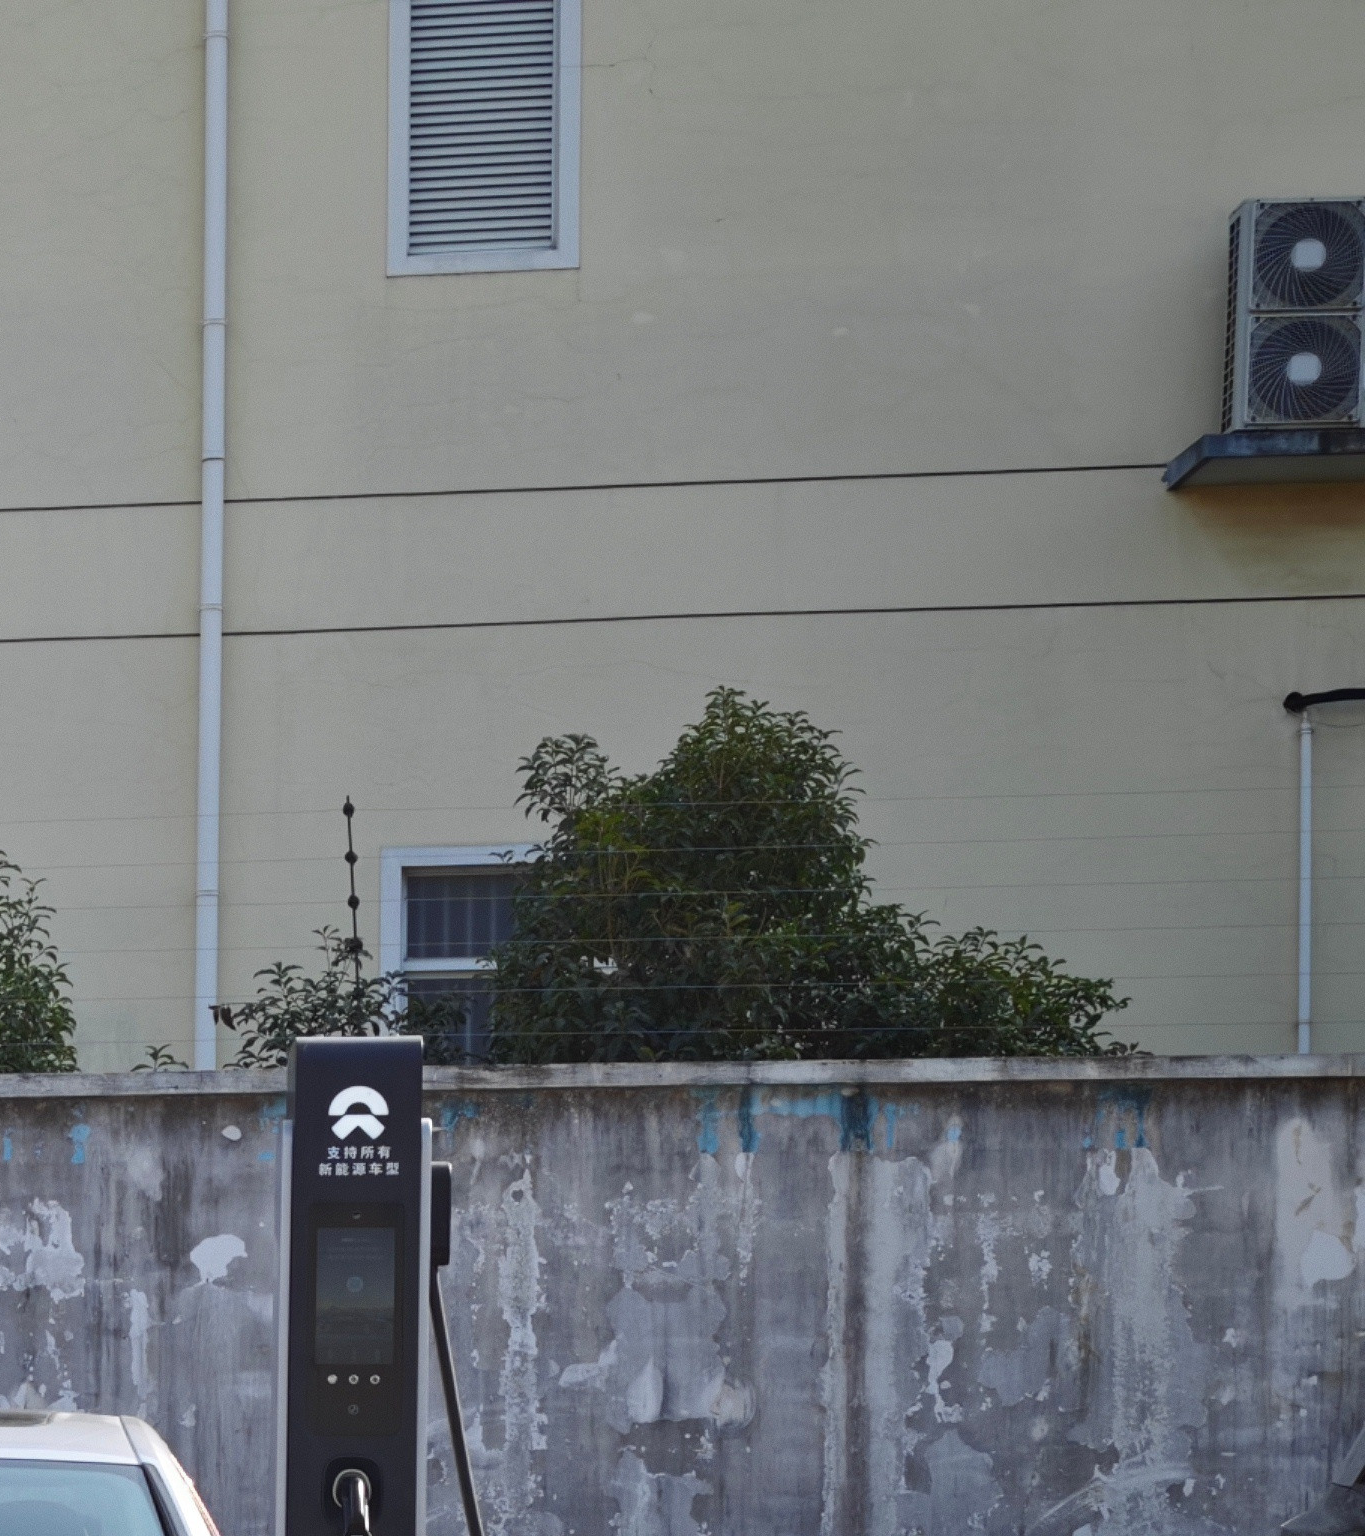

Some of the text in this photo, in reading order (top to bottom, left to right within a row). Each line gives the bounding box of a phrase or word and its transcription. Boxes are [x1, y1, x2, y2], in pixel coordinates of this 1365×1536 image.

[327, 1145, 391, 1160] 支持所有
[318, 1162, 400, 1176] 新能源车型
